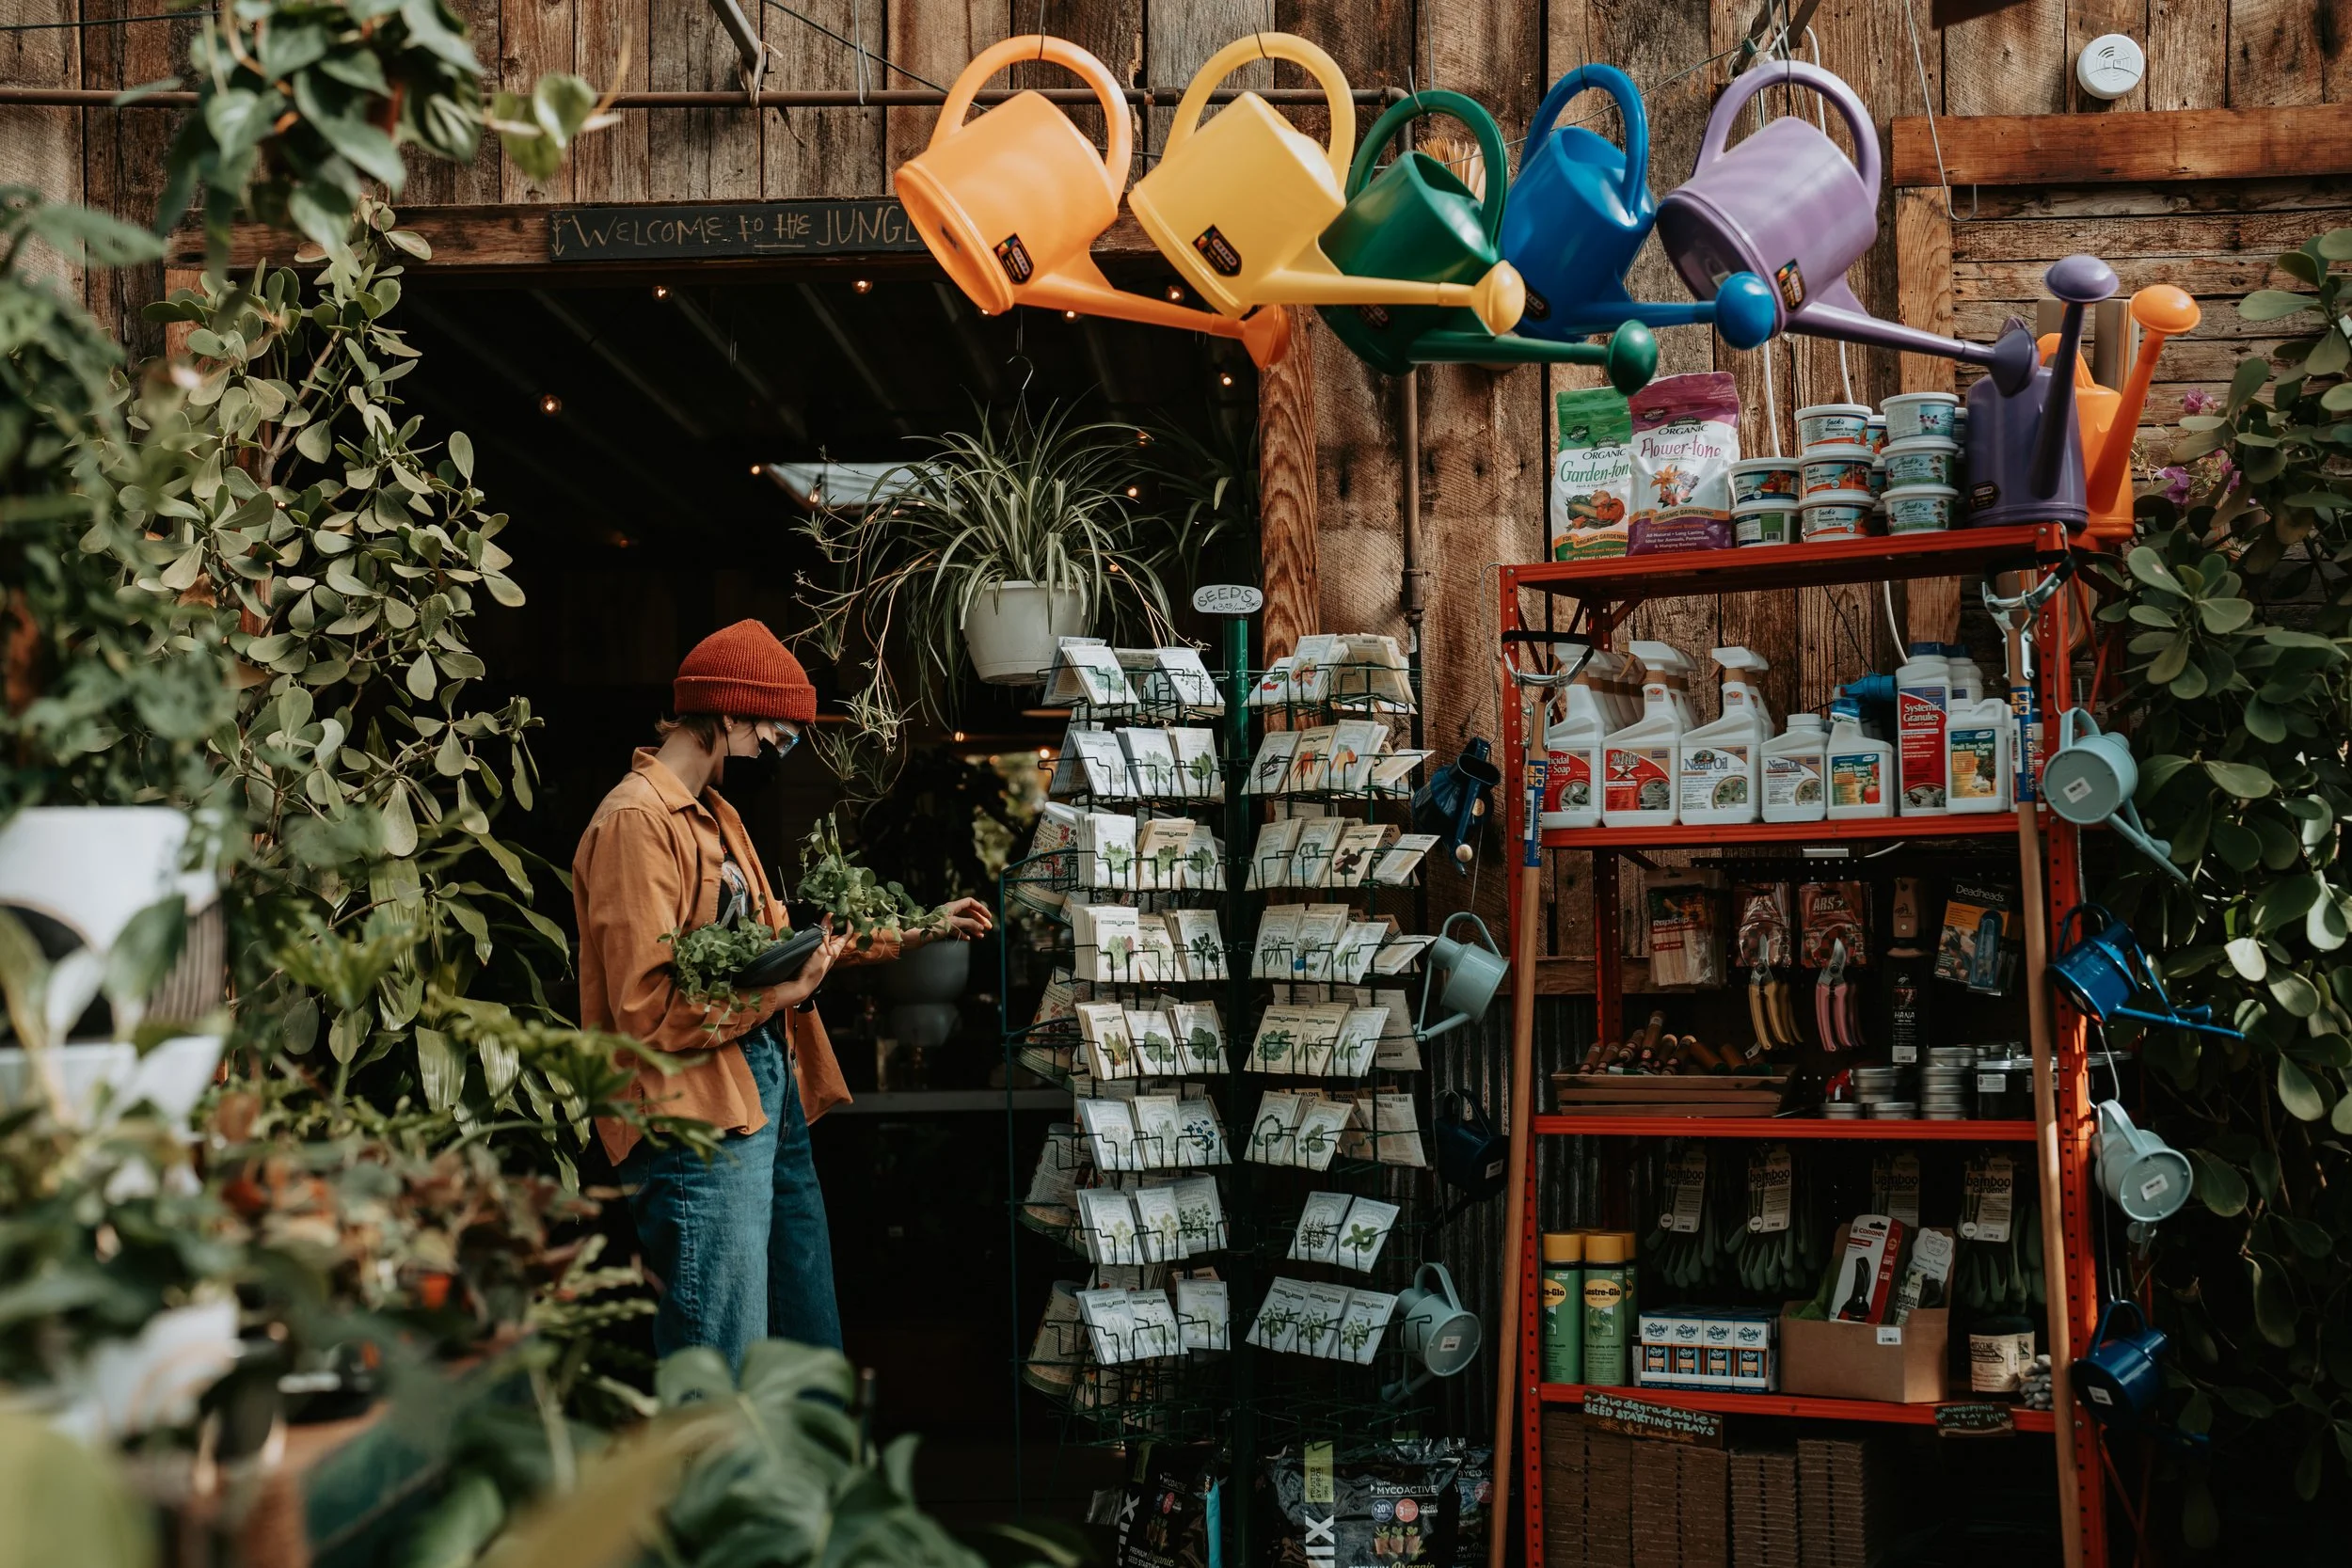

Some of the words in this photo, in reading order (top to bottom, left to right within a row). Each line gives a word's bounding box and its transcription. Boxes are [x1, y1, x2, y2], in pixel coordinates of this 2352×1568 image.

[572, 214, 722, 247] WELCOME
[774, 213, 810, 241] THE
[818, 207, 918, 245] JUNGL
[1659, 424, 1708, 436] ORGANIC
[1641, 435, 1722, 458] Flower-tone
[1582, 449, 1627, 460] ORGANIC
[1560, 460, 1631, 483] Garden-ton
[1577, 535, 1598, 546] ORGANIC
[1198, 587, 1253, 607] SEEDS
[1904, 702, 1943, 714] Systemic
[1903, 712, 1940, 722] Granules
[1553, 764, 1571, 775] Soap
[1713, 757, 1728, 769] Oil
[1956, 884, 2005, 902] Deadheads
[1813, 897, 1836, 911] ARS
[1653, 917, 1690, 927] RapiClip
[1894, 1011, 1915, 1020] HANA
[1665, 1164, 1704, 1180] bamboo
[1750, 1169, 1790, 1183] bamboo
[1874, 1170, 1918, 1185] bamboo
[1966, 1173, 2010, 1187] bamboo
[1858, 1227, 1885, 1238] CORONA
[1584, 1402, 1613, 1417] SEED
[1616, 1409, 1673, 1429] STARTING
[1675, 1421, 1715, 1436] TRAYS
[1376, 1484, 1438, 1495] MYCOACTIVE
[1129, 1545, 1148, 1559] PREMIUM
[1147, 1550, 1175, 1567] Organic
